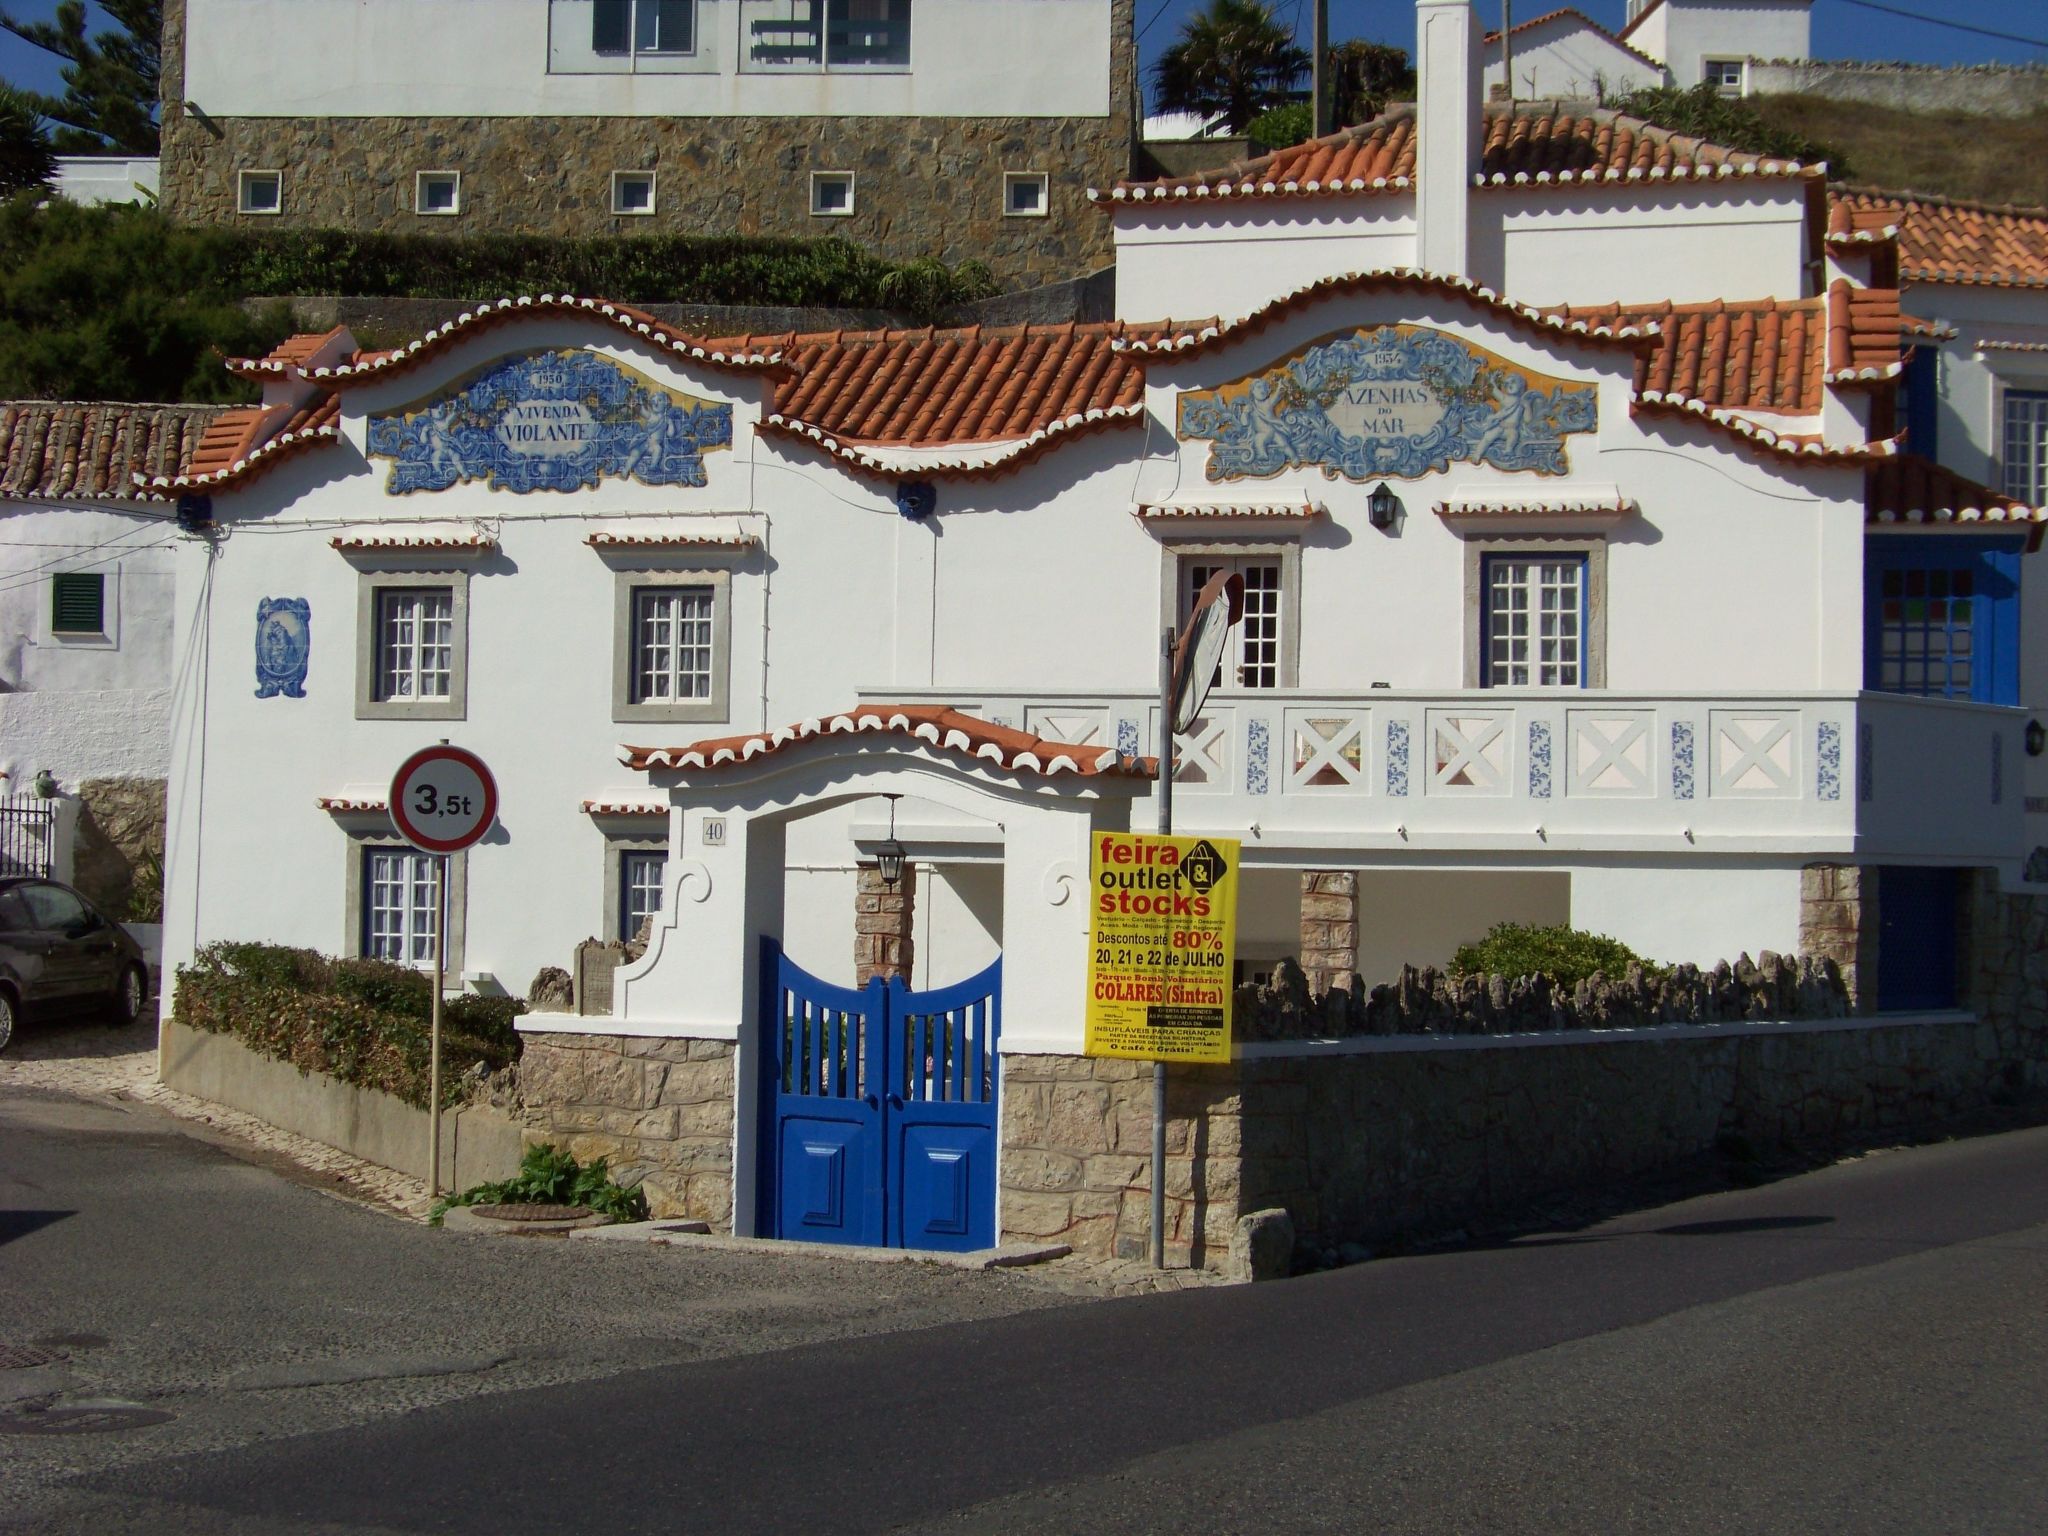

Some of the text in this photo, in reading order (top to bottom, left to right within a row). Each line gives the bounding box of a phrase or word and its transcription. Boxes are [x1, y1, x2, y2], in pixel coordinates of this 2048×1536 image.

[539, 373, 563, 385] 1950
[1344, 387, 1428, 405] AZENHAS
[516, 405, 580, 419] VIVENDA
[504, 423, 589, 441] VIOLANTE
[1363, 417, 1404, 434] MAR
[414, 784, 471, 818] 3,5t
[705, 822, 723, 840] 40
[1100, 836, 1179, 866] feira
[1099, 866, 1182, 890] outlet
[1193, 864, 1209, 882] &
[1099, 888, 1211, 917] stocks
[1097, 930, 1224, 950] Descontos até 80%
[1096, 948, 1225, 968] 20, 21 e 22 de JULHO
[1095, 972, 1132, 983] Parque
[1167, 976, 1224, 985] Voluntários
[1094, 981, 1223, 1005] COLARES (Sintra)
[1094, 1026, 1150, 1034] INSUFLÁVEIS
[1176, 1029, 1221, 1037] CRIANÇAS
